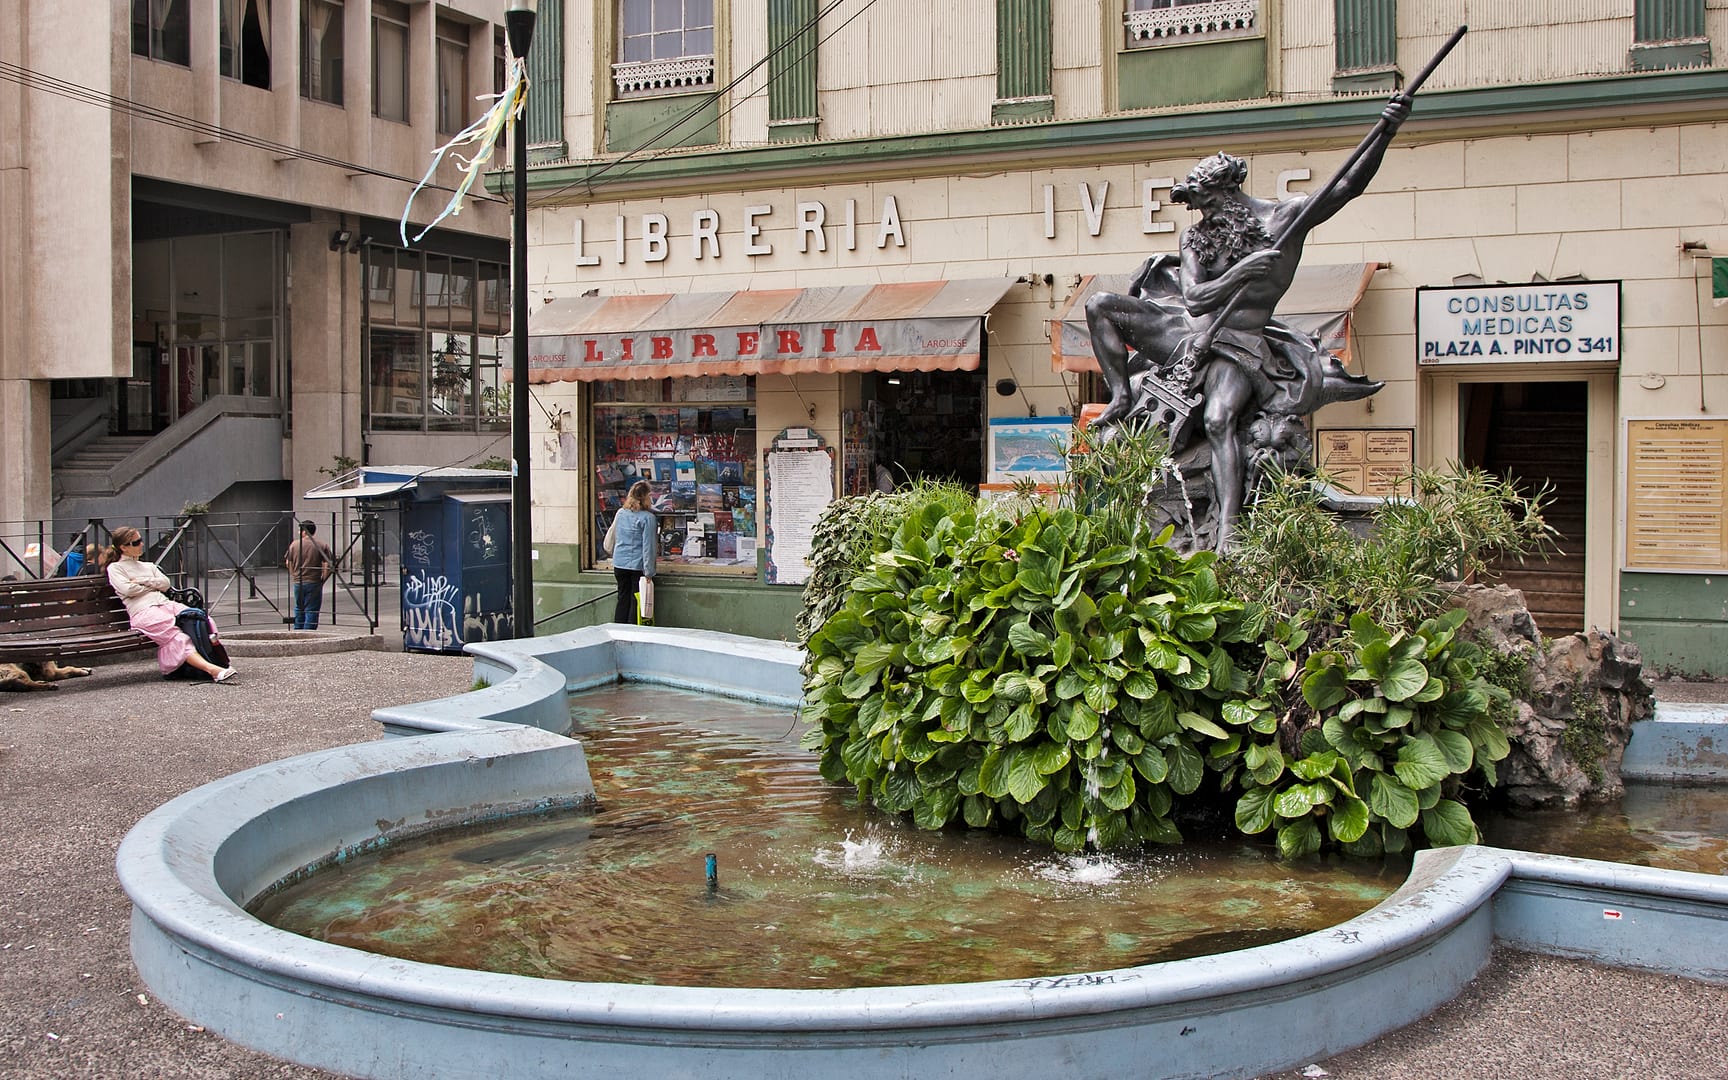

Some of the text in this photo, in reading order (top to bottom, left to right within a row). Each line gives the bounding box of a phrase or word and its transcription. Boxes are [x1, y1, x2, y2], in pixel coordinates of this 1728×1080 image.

[575, 168, 1312, 267] LIBRERIA IVES
[1447, 292, 1588, 314] CONSULTAS
[1462, 315, 1573, 335] MEDICAS
[584, 327, 882, 362] LIBRERIA
[922, 338, 968, 348] LAROUSSE
[1425, 337, 1612, 357] PLAZA A. PINTO 341
[615, 434, 674, 451] LIBRERIA
